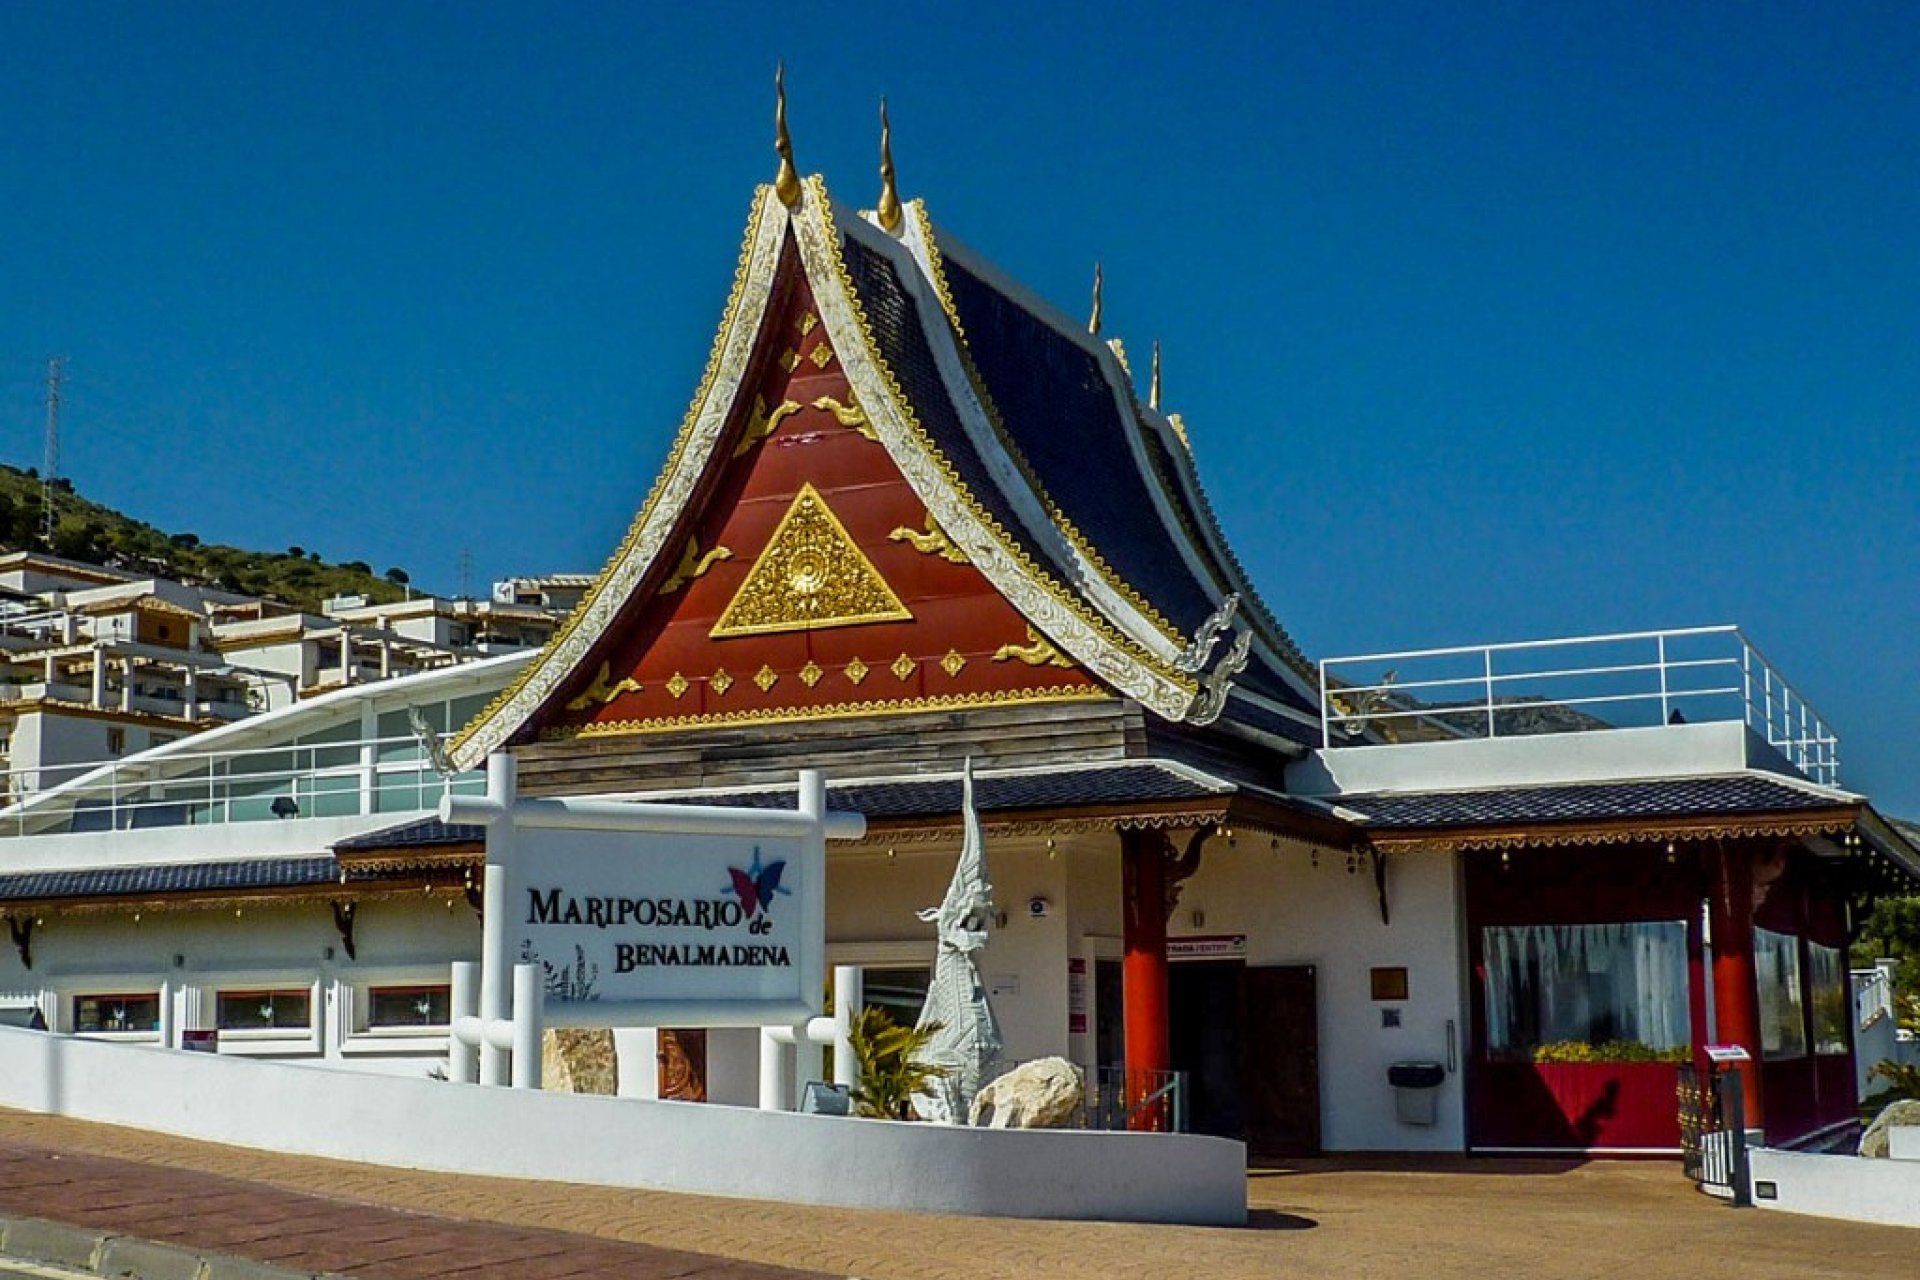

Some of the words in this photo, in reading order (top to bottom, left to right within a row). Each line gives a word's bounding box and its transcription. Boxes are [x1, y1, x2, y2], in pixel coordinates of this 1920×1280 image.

[526, 888, 742, 929] MARIPOSARIO
[748, 914, 773, 935] de
[614, 943, 791, 974] BENALMADENA
